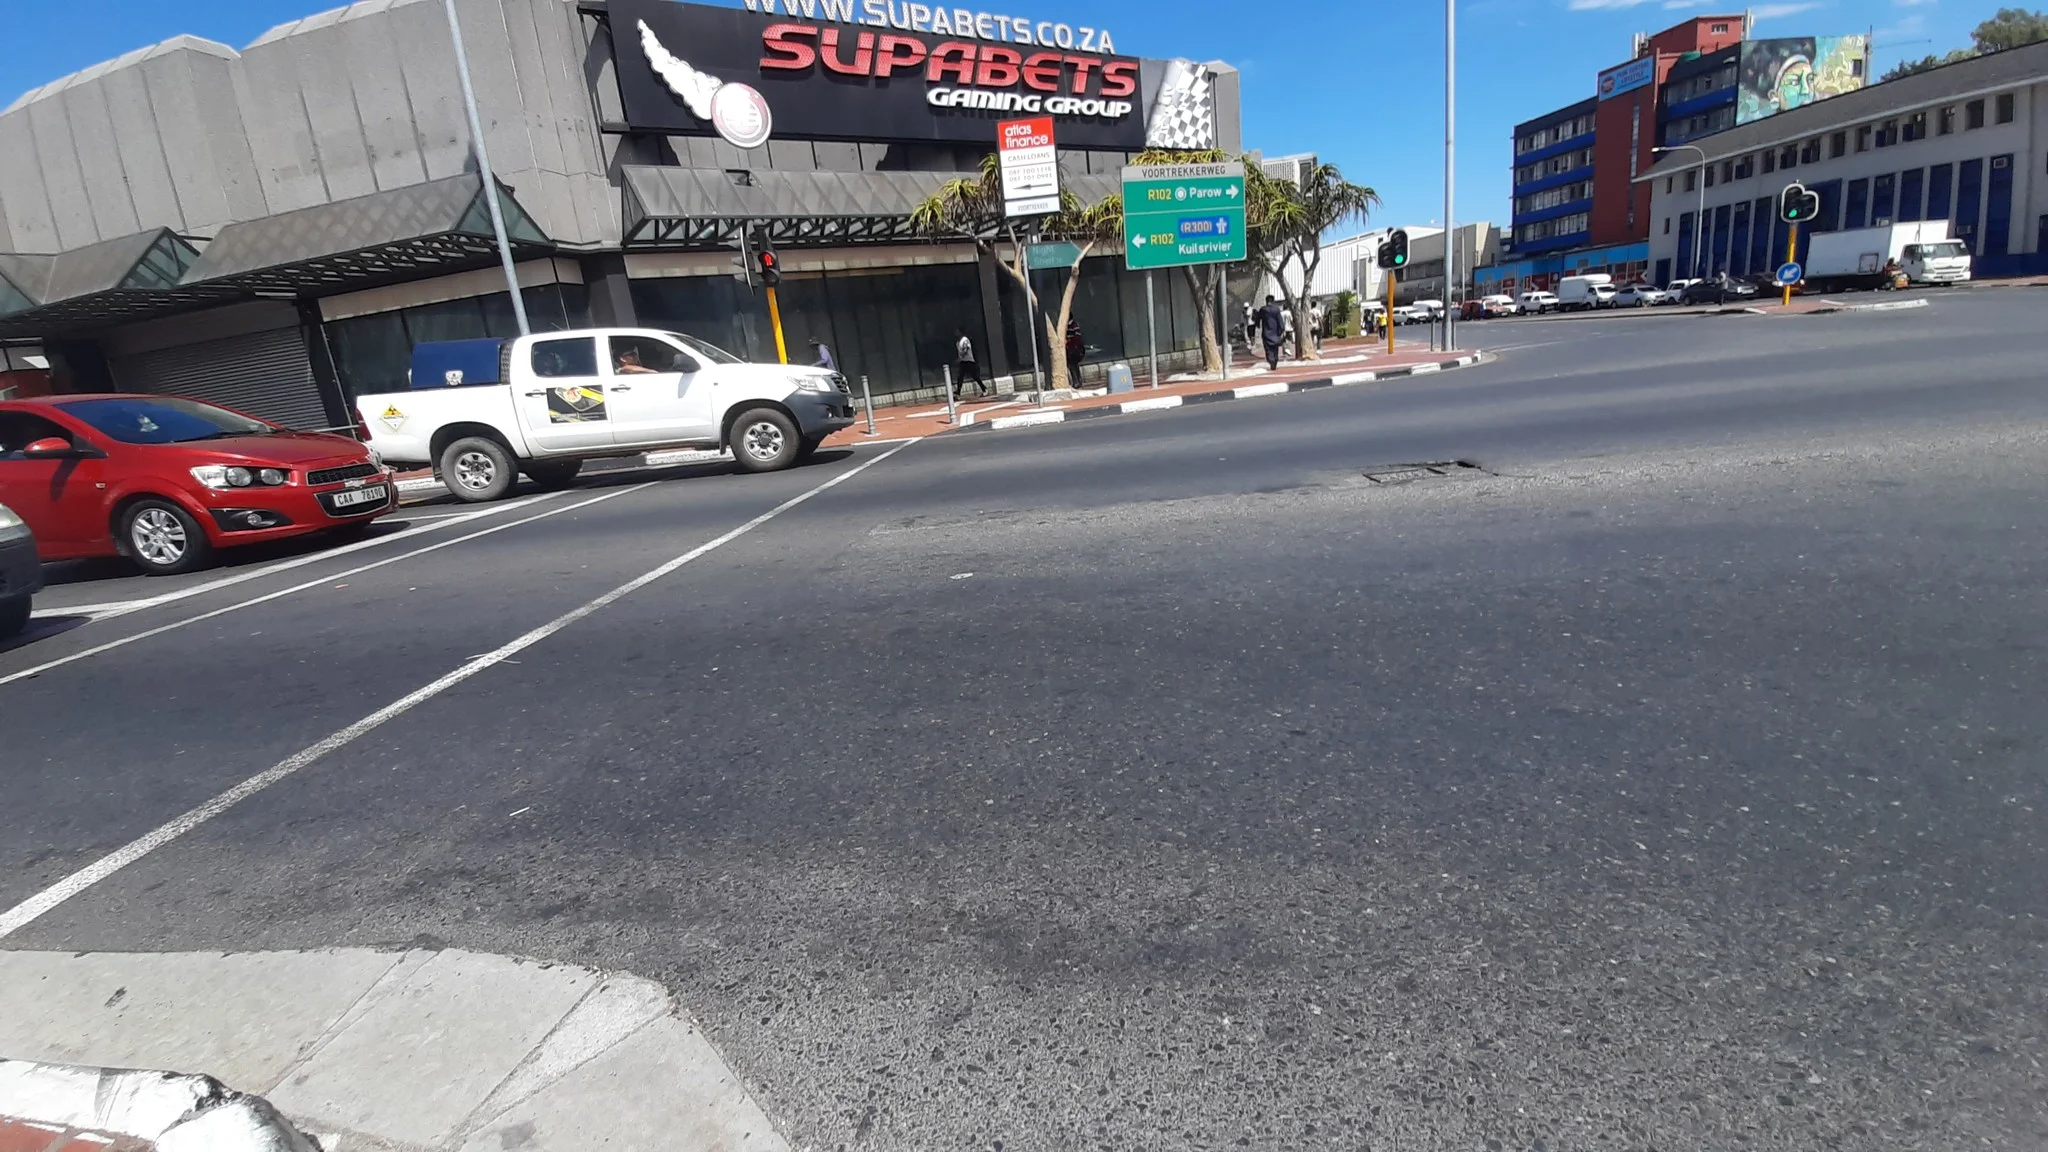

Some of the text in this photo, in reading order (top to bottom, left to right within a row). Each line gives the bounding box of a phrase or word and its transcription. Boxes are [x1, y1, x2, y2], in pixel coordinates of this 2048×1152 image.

[760, 23, 1139, 97] SUPABETS
[927, 87, 1132, 117] GAMING GROUP
[1005, 124, 1031, 136] atlas
[1006, 135, 1048, 148] finance
[1008, 152, 1050, 162] CASH LOANS
[1142, 166, 1226, 178] VOORTREKKERWEG
[1148, 187, 1222, 200] R102 Parow
[1181, 221, 1213, 233] (R300)
[1150, 234, 1174, 245] R102
[1178, 242, 1232, 255] Kuilsrivier
[337, 487, 384, 505] CAA 78190
